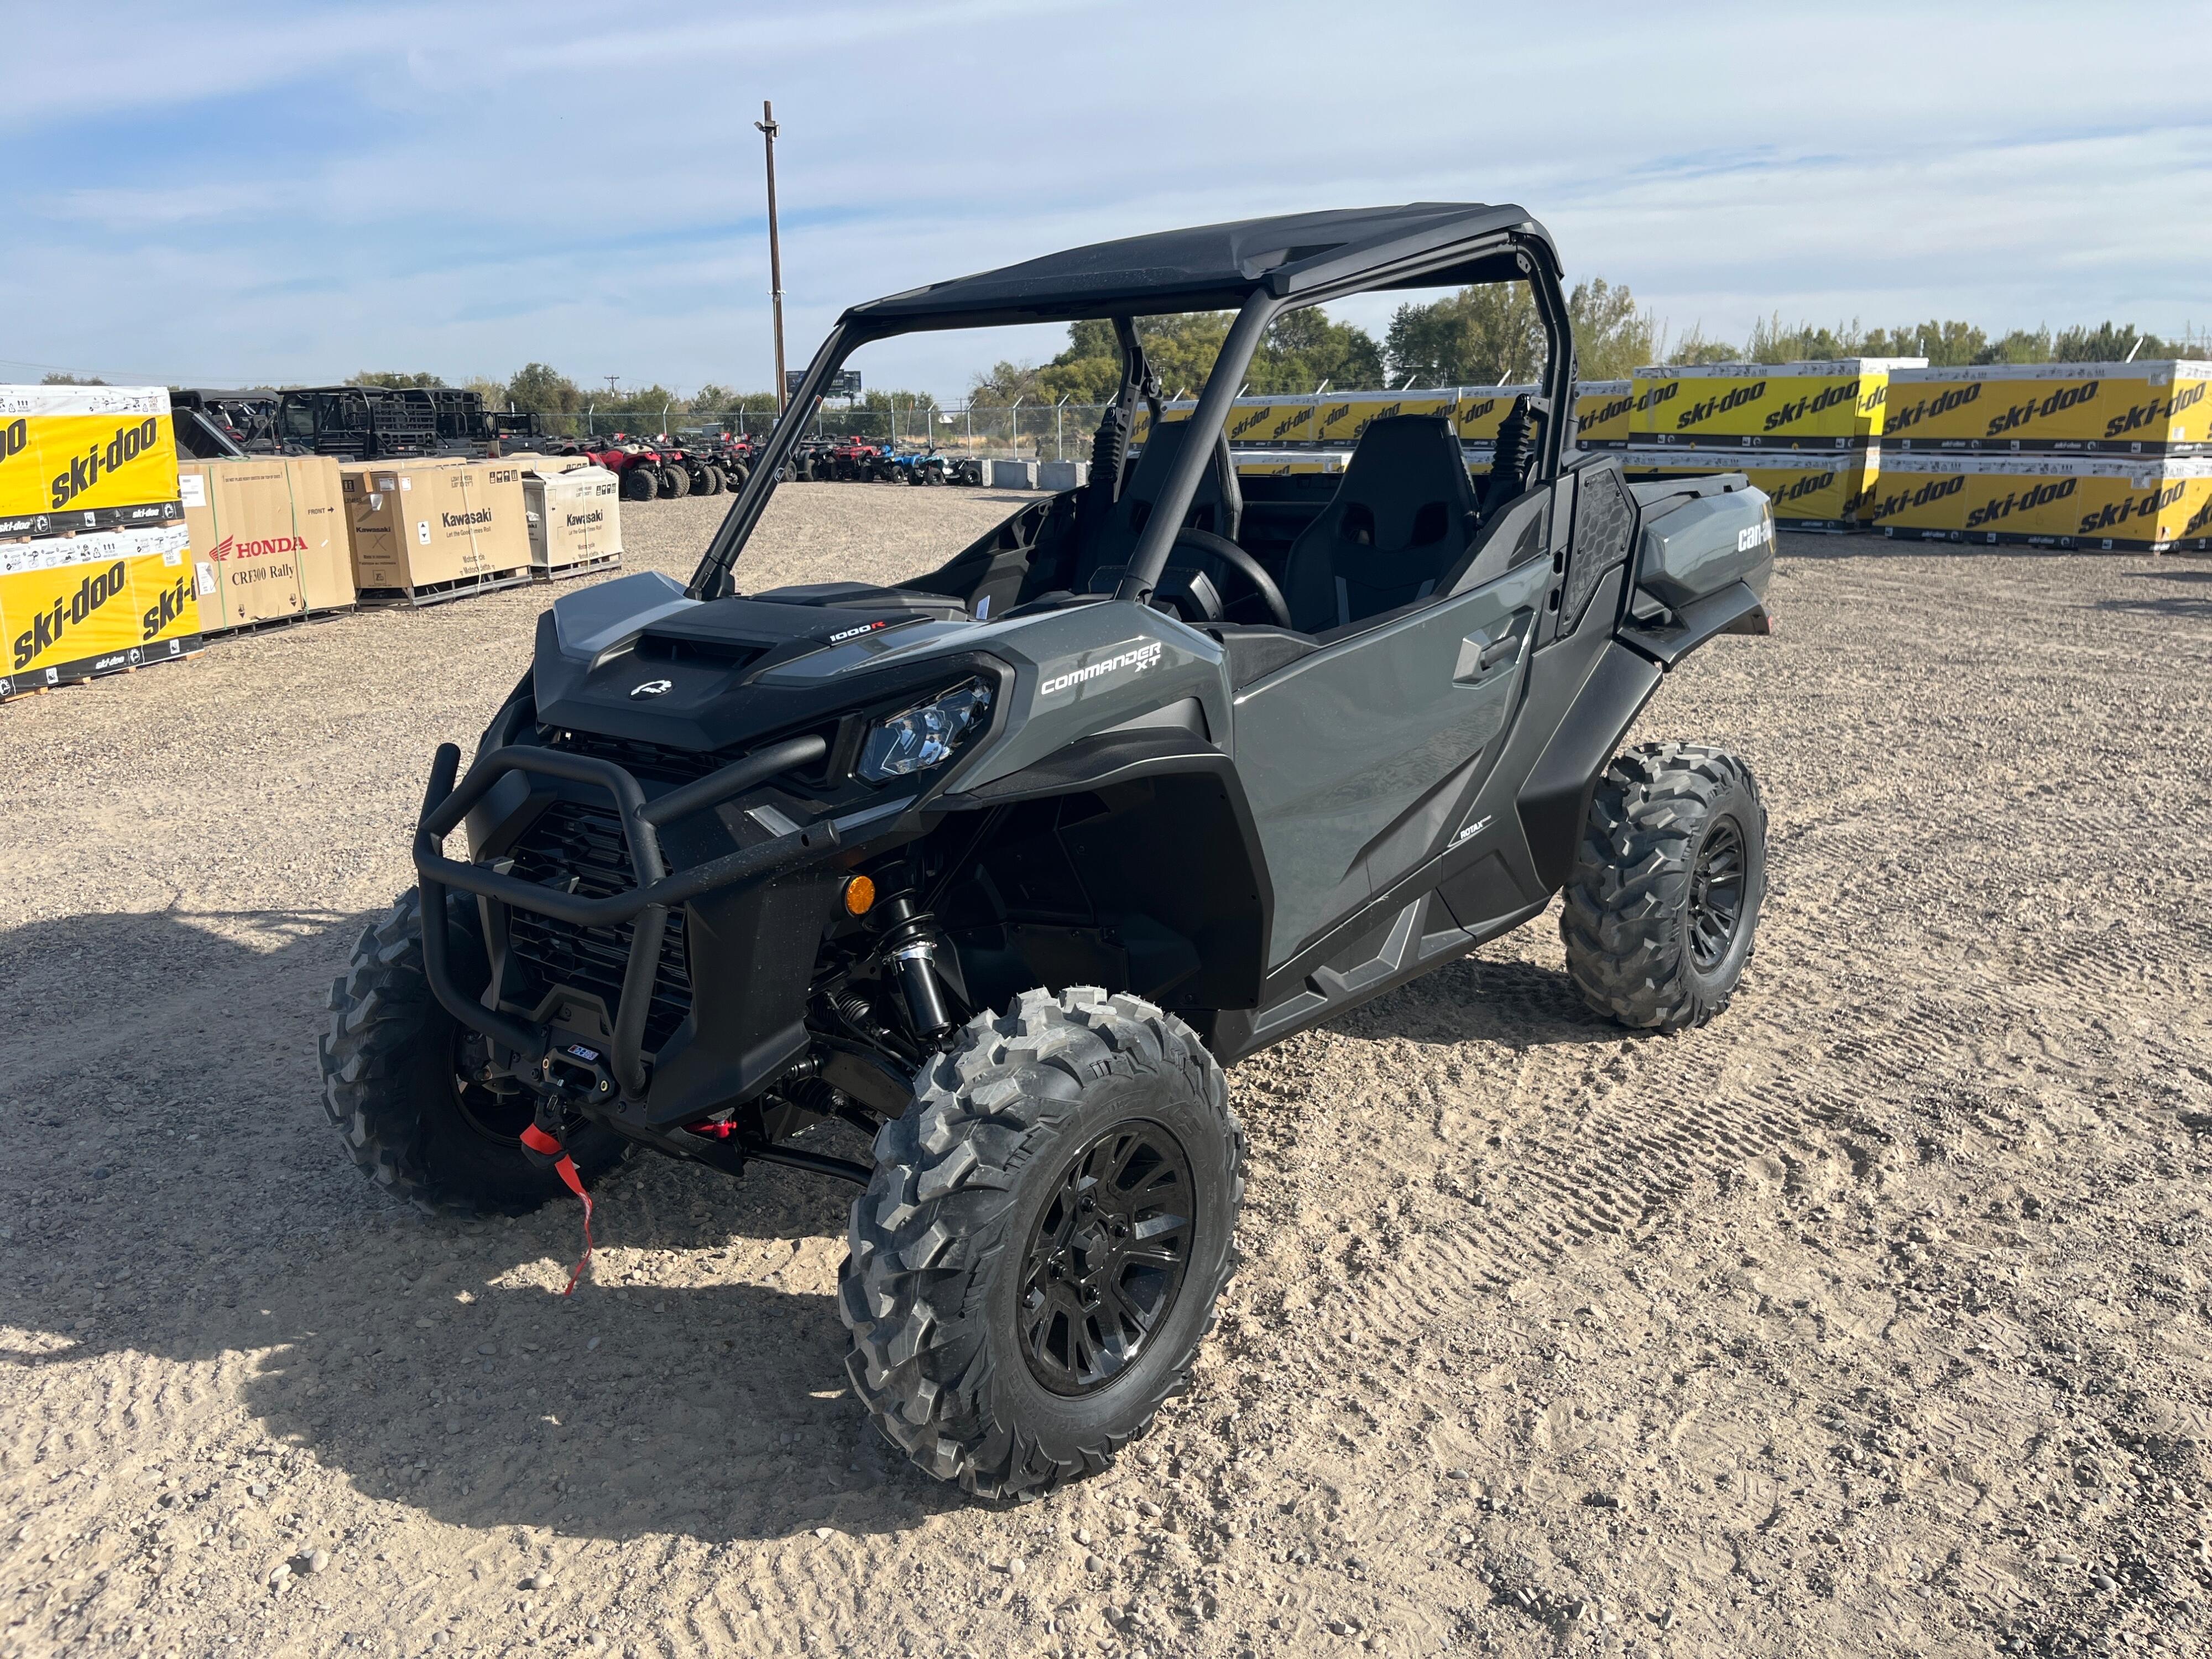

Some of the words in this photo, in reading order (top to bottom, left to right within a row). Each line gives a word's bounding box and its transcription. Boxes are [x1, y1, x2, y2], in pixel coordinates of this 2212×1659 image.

[1231, 406, 1270, 439] ski-doo
[1273, 406, 1315, 440] ski-doo
[1578, 397, 1634, 434] ki-doo
[1677, 382, 1766, 429] ski-doo
[1763, 380, 1860, 431] ski-doo
[1882, 383, 1981, 436] ski-doo
[1986, 381, 2099, 436] ski-doo
[2105, 382, 2206, 438] ski-doo
[52, 418, 156, 509] ski-doo
[132, 508, 159, 518] ski-doo
[1872, 476, 1965, 520] ski-doo
[1966, 478, 2077, 528] ski-doo
[2078, 480, 2186, 534] ski-doo
[442, 507, 492, 528] Kawasaki
[567, 509, 603, 526] Kawasaki
[236, 536, 308, 559] HONDA
[462, 553, 486, 563] Motorccle
[232, 567, 266, 586] CRF300
[270, 564, 294, 579] Rally
[14, 561, 125, 670] ski-doo
[830, 621, 886, 641] 1000R
[1041, 641, 1161, 695] COMMANDER
[1135, 654, 1161, 672] XT
[1460, 821, 1483, 839] ROTAX
